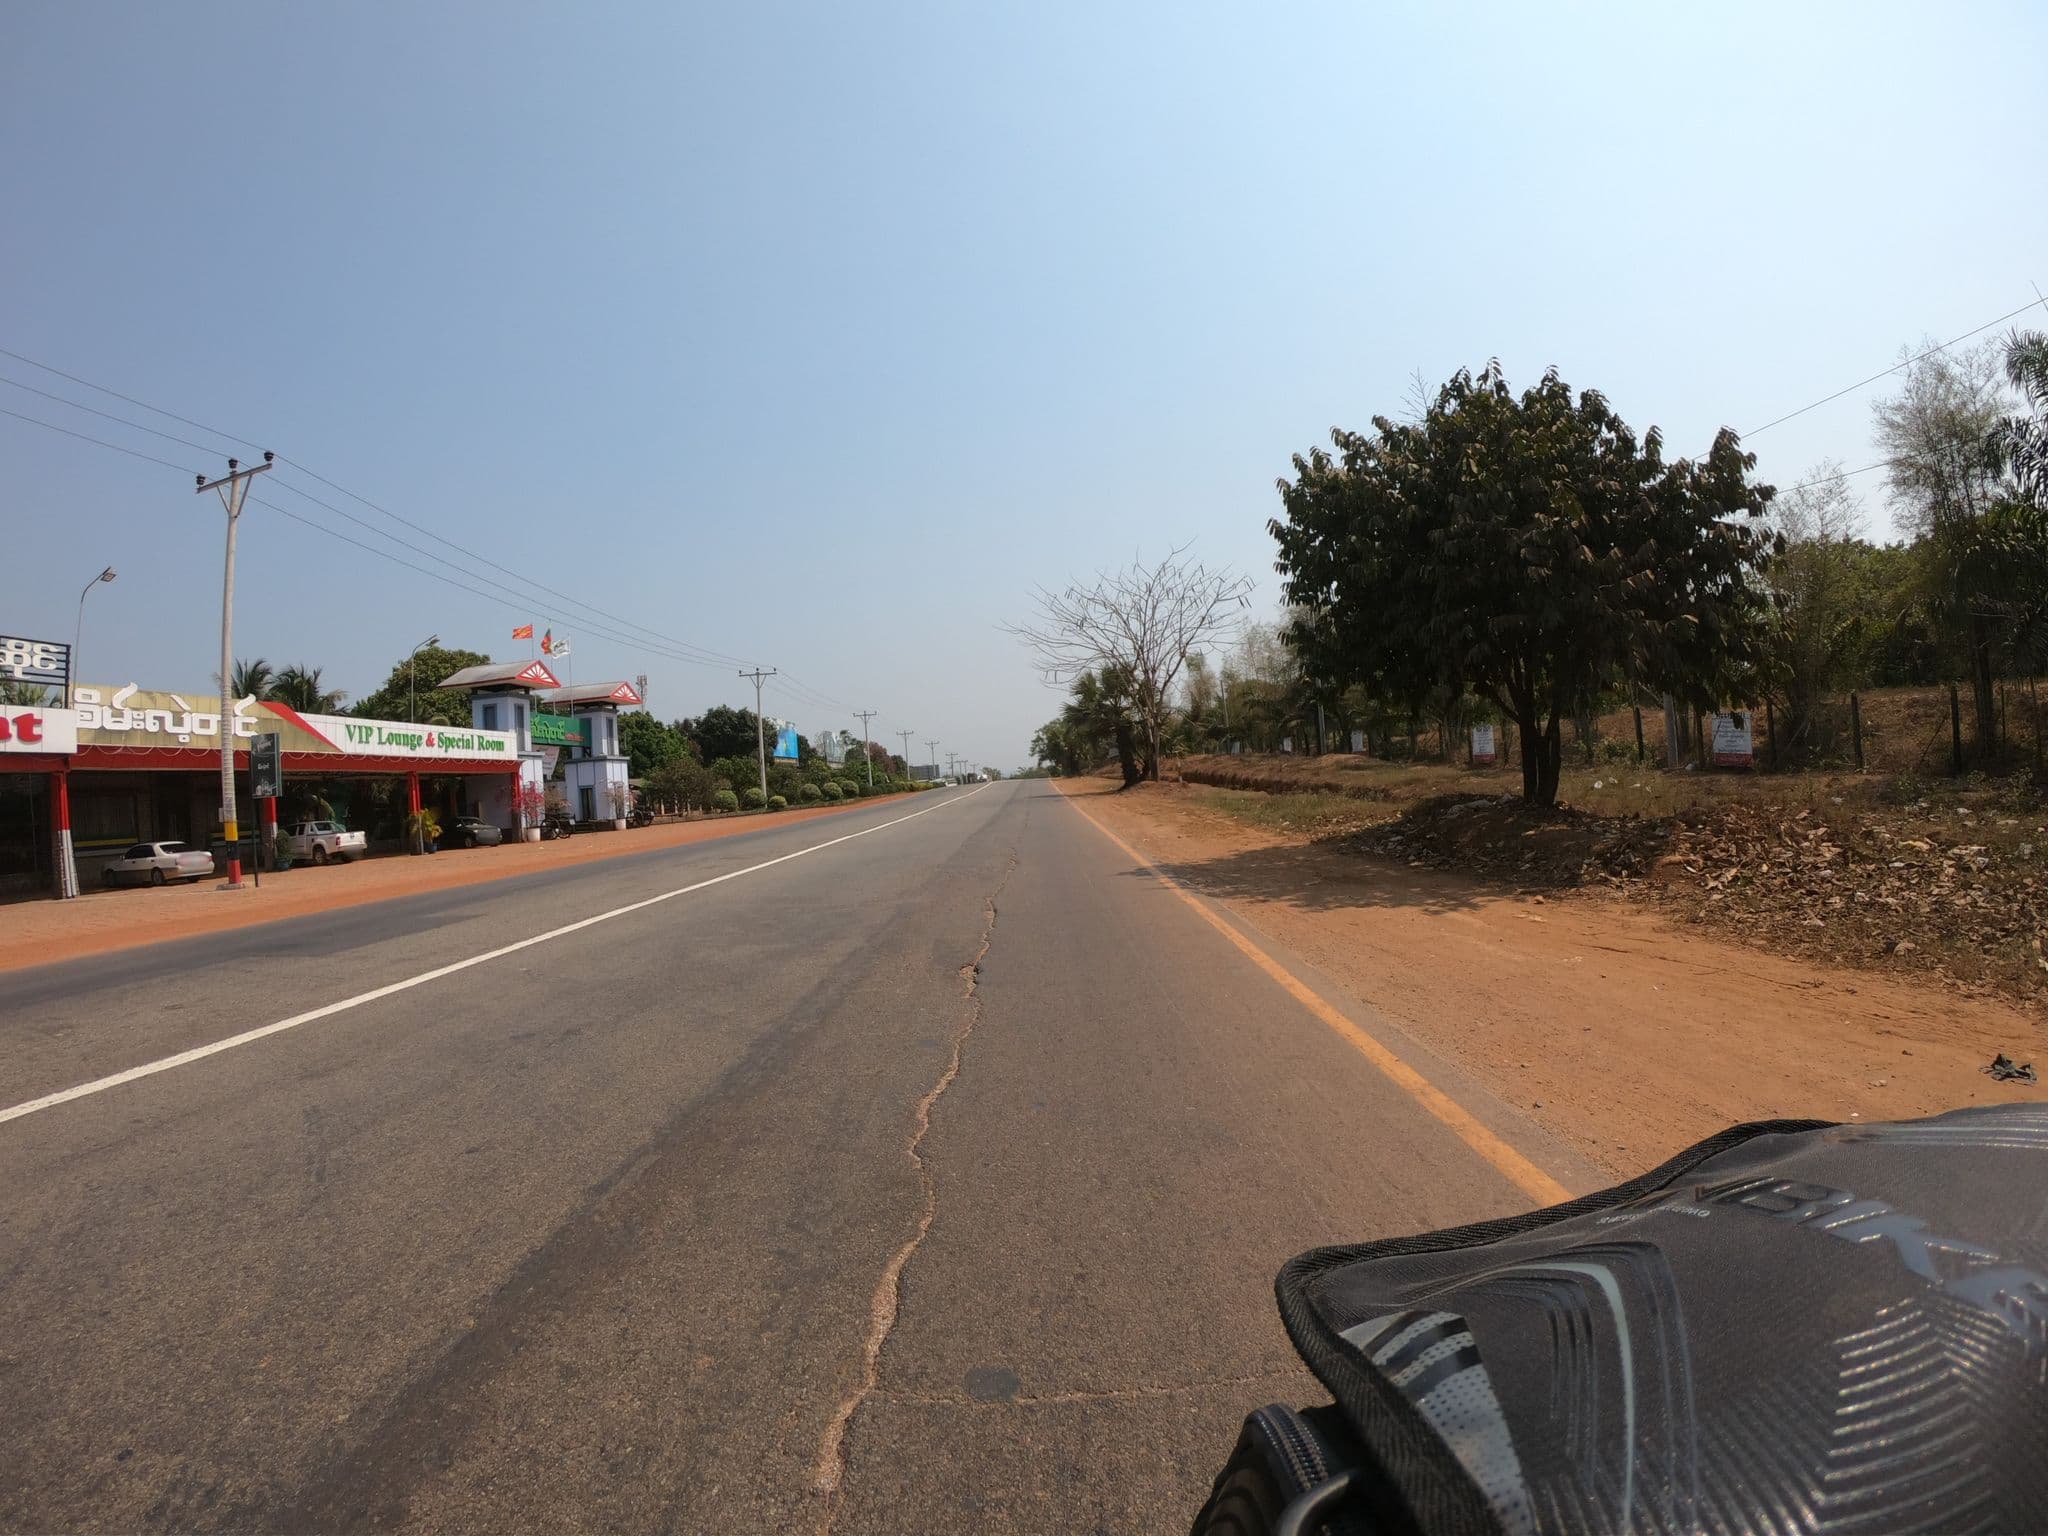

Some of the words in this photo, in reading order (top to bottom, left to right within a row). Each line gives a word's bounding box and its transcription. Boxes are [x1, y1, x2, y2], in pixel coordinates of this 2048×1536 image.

[345, 724, 374, 744] VIP
[378, 727, 423, 750] Lounge
[425, 732, 436, 748] &
[437, 732, 475, 753] Special
[477, 735, 505, 752] Room
